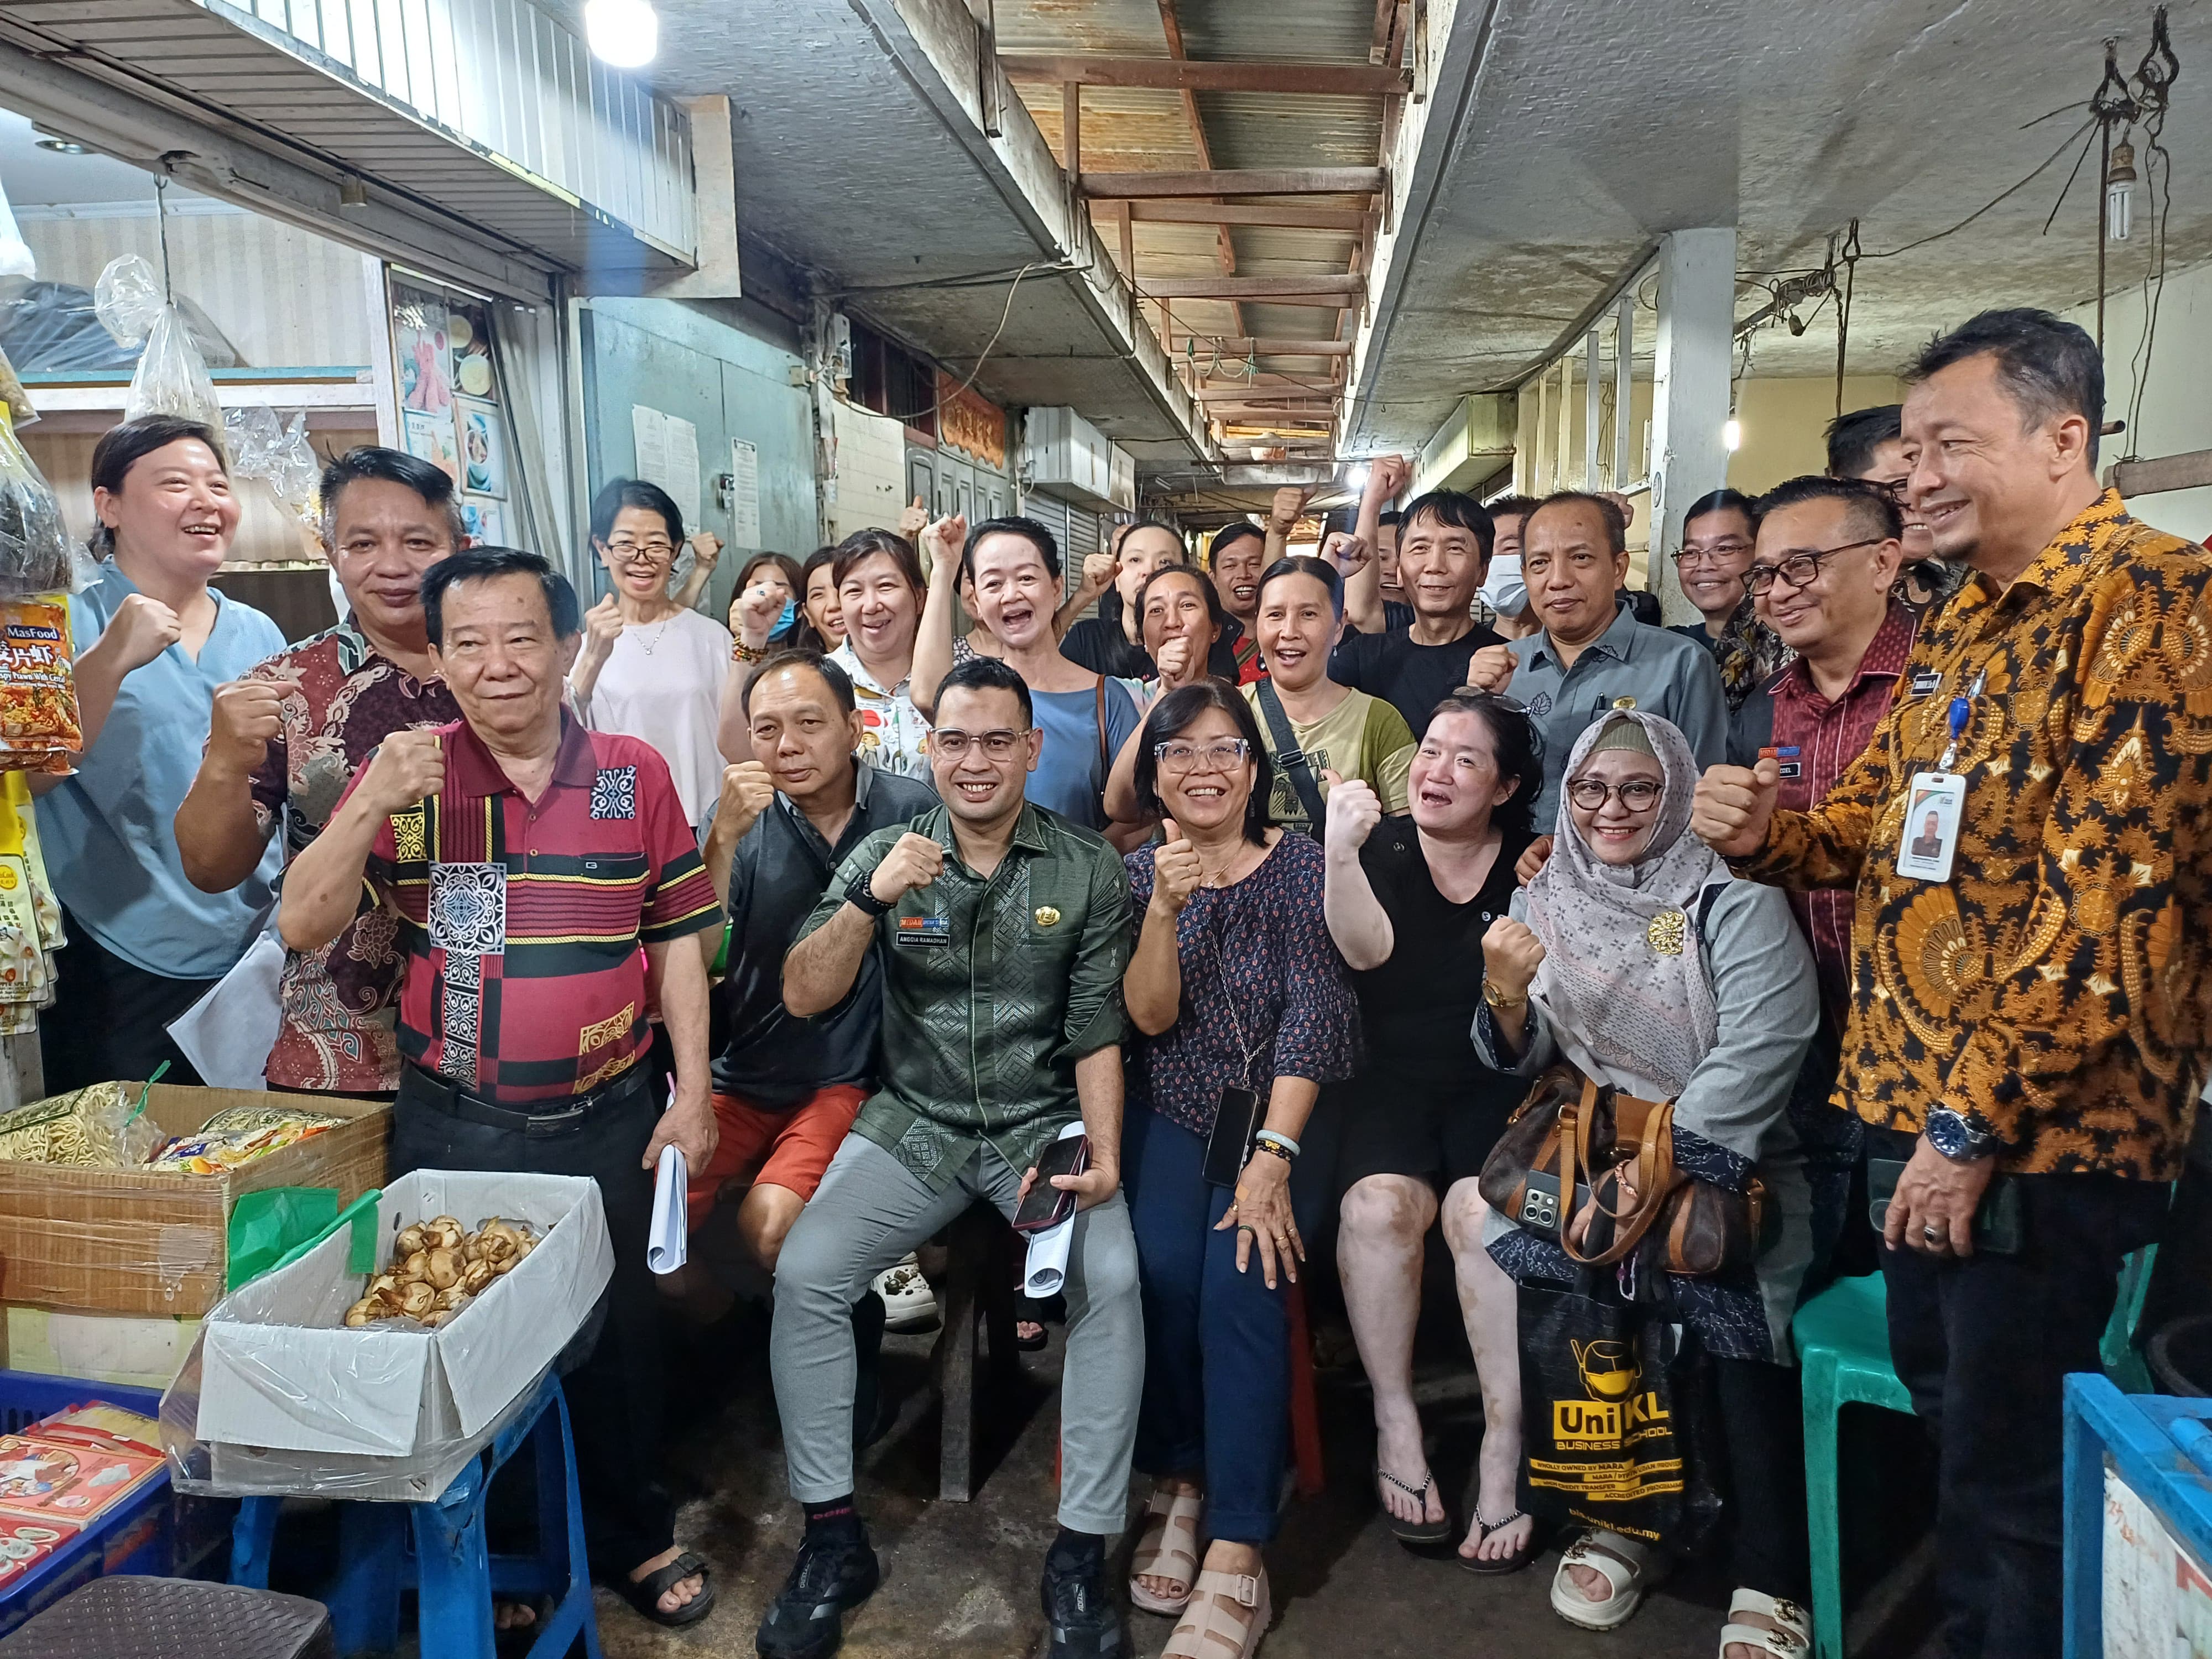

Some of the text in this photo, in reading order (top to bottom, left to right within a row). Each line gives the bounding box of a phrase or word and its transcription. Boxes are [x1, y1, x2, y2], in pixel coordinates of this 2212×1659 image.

[7, 627, 58, 639] MasFood
[12, 671, 33, 680] Prawn
[1556, 1426, 1673, 1451] BUSINESS SCHOOL
[1537, 1462, 1560, 1470] WHOLLY
[1604, 1488, 1645, 1499] ACCREDITED
